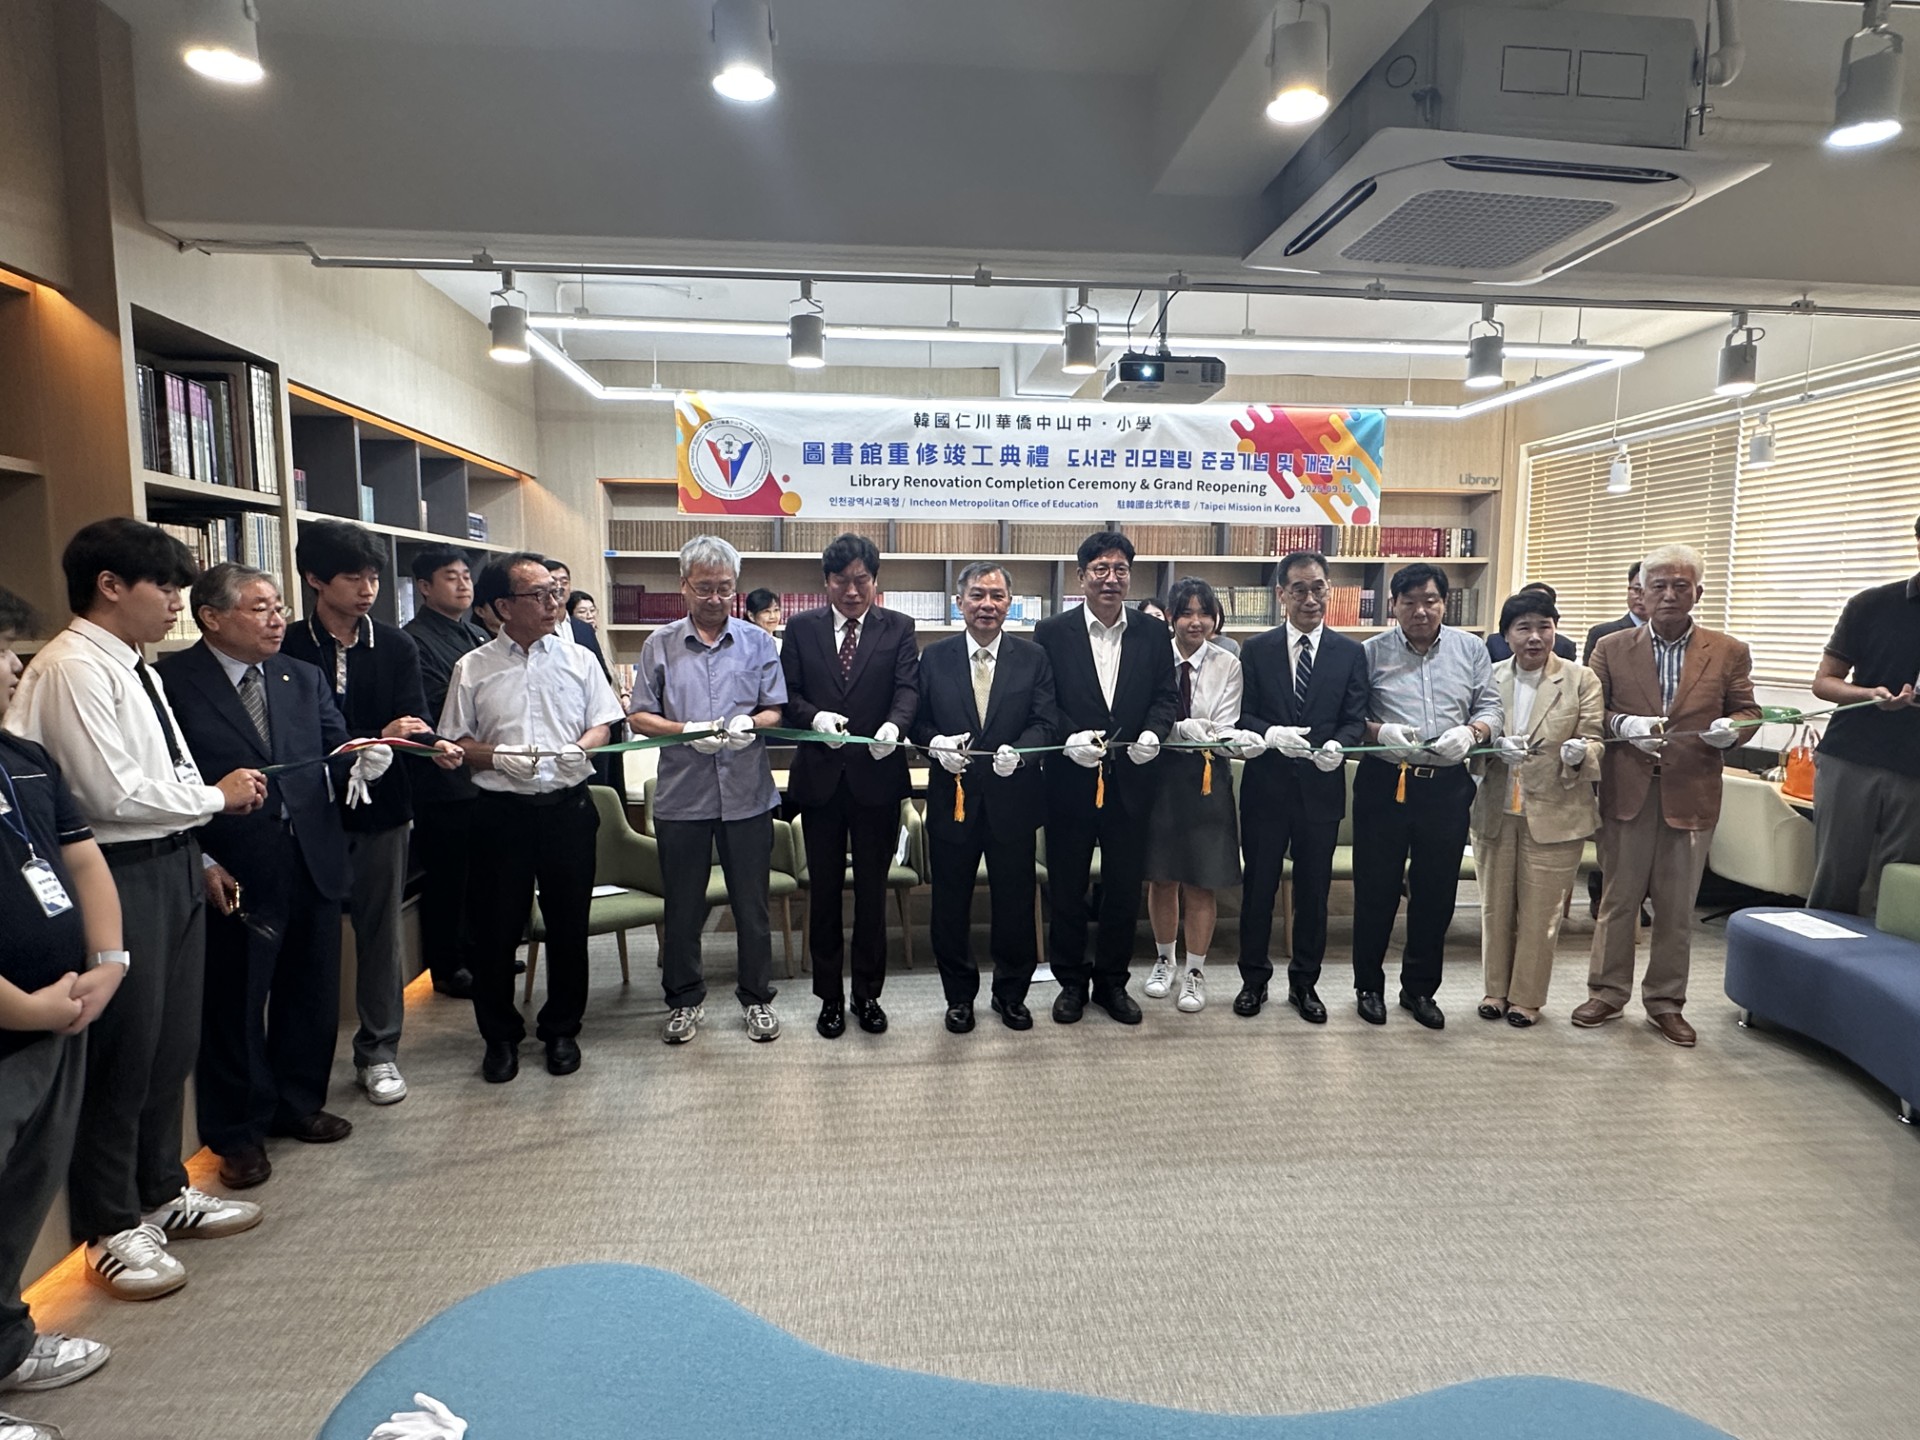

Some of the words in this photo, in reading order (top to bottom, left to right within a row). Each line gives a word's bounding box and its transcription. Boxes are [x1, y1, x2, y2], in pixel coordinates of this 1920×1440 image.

[803, 441, 1049, 468] 圖書館重修竣工典禮
[1067, 449, 1116, 468] 도서관
[1125, 449, 1192, 469] 리모델링
[1201, 451, 1269, 472] 준공기념
[1278, 454, 1293, 472] 및
[1303, 455, 1351, 474] 개관식
[850, 474, 900, 490] Library
[903, 475, 982, 489] Renovation
[985, 476, 1065, 492] Completion
[1068, 478, 1137, 493] Ceremony
[1140, 479, 1150, 490] &
[1154, 478, 1193, 491] Grand
[1197, 480, 1267, 497] Reopening
[1459, 472, 1499, 487] Library
[829, 496, 899, 507] 인천광역시교육청
[909, 497, 947, 507] Incheon
[949, 498, 1010, 509] Metropolitan
[1012, 499, 1039, 508] Office
[1041, 499, 1050, 508] of
[1053, 499, 1099, 509] Education
[1200, 502, 1226, 512] Taipei
[1228, 502, 1261, 512] Mission
[1264, 502, 1272, 512] in
[1274, 504, 1300, 513] Korea
